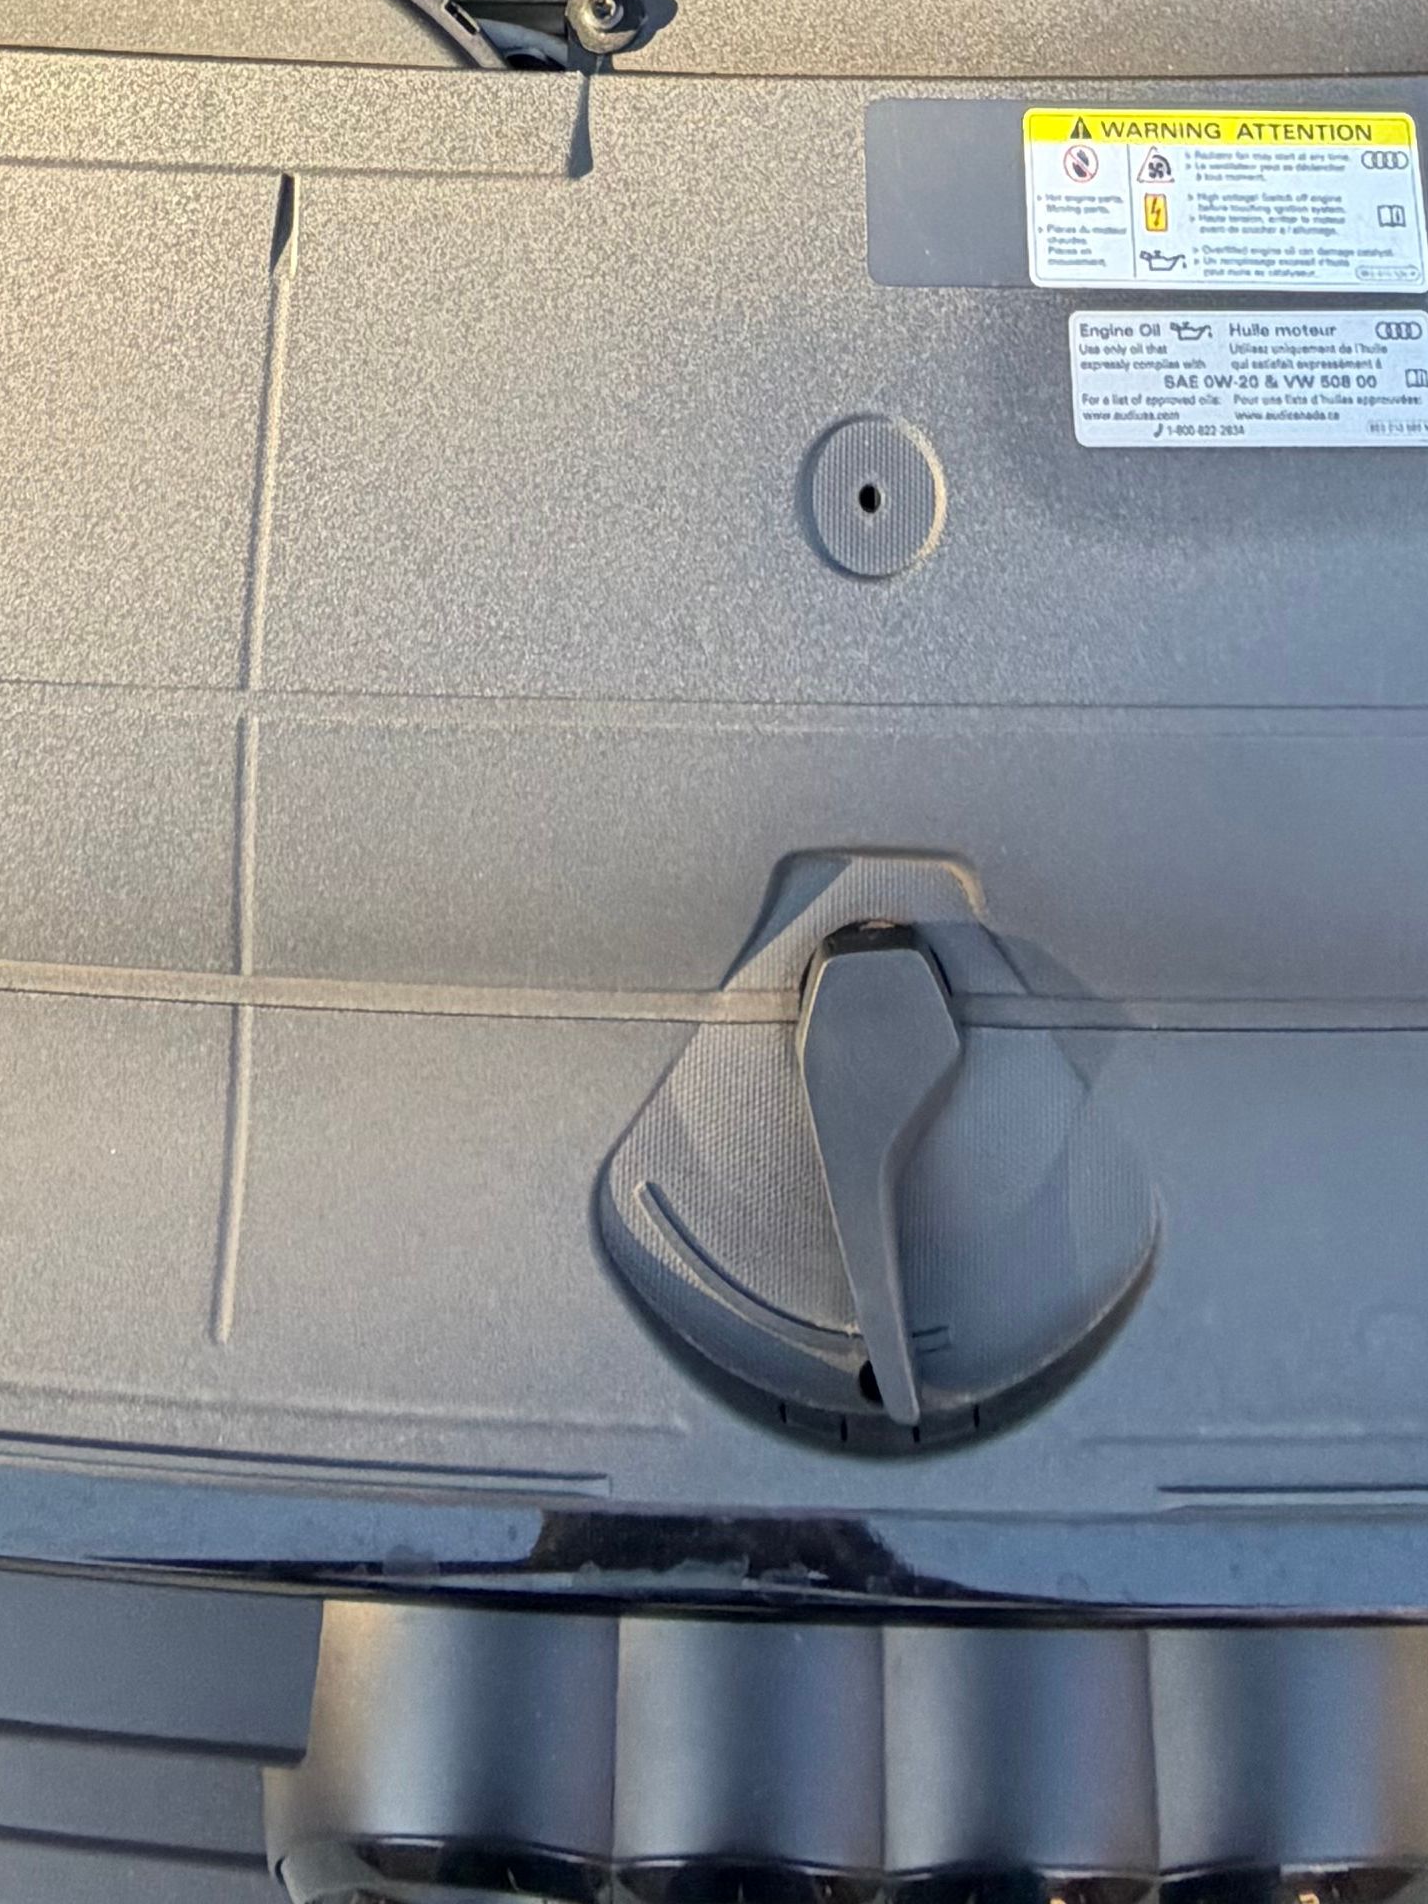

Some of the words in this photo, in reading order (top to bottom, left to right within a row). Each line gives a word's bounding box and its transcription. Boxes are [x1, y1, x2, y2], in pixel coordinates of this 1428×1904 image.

[1100, 120, 1221, 140] WARNING
[1236, 122, 1372, 141] ATTENTION
[1079, 323, 1133, 339] Engine
[1139, 323, 1161, 337] Oil
[1229, 323, 1270, 337] Huile
[1275, 324, 1337, 337] moteur
[1079, 344, 1100, 355] Use
[1103, 344, 1127, 357] only
[1130, 344, 1143, 355] oil
[1145, 344, 1167, 355] that
[1271, 343, 1336, 356] uniquement
[1182, 358, 1207, 370] with
[1230, 358, 1249, 370] qui
[1164, 374, 1199, 389] SAE
[1203, 374, 1259, 389] 0W-20
[1264, 374, 1278, 389] &
[1283, 375, 1316, 388] VW
[1320, 375, 1351, 389] 508
[1355, 375, 1378, 389] 00
[1082, 393, 1100, 405] For
[1112, 393, 1129, 406] list
[1131, 393, 1142, 405] of
[1145, 394, 1196, 407] approved
[1233, 394, 1259, 405] Pour
